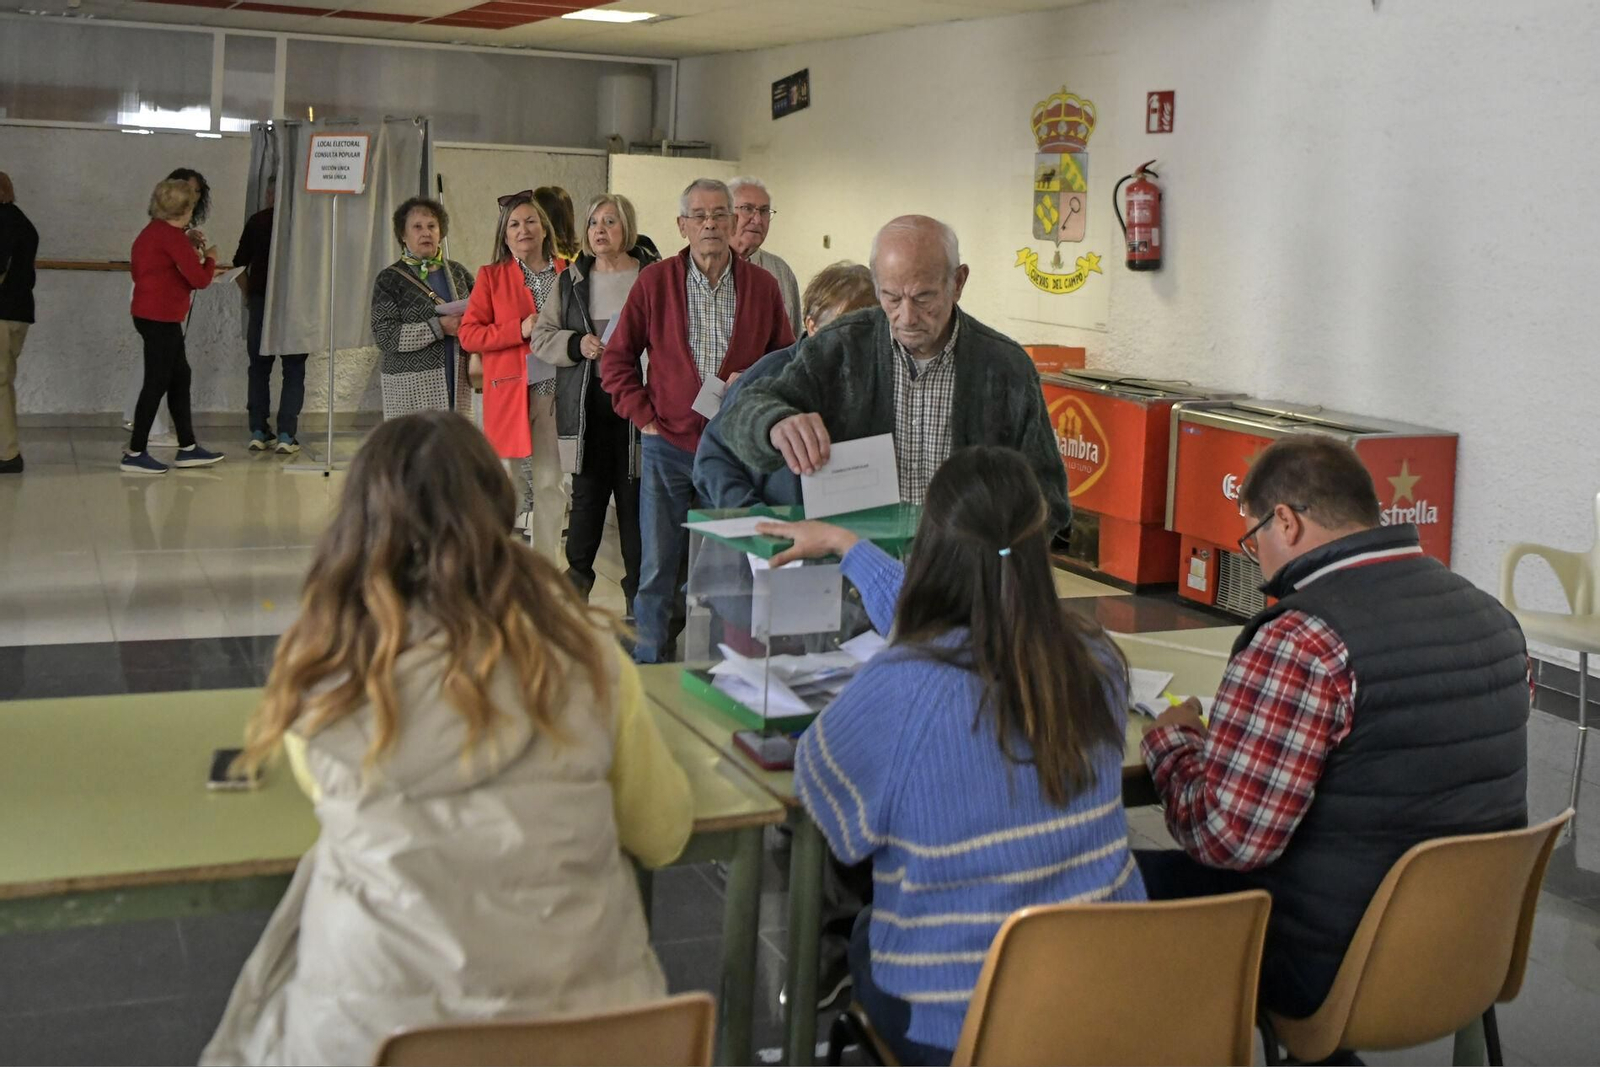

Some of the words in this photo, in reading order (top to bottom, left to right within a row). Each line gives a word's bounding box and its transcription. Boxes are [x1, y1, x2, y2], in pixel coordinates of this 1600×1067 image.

[317, 140, 332, 148] LOCAL
[332, 140, 360, 148] ELECTORAL
[1030, 268, 1049, 289] CUEVAS
[1052, 278, 1063, 290] DEL
[1064, 272, 1083, 289] CAMPO
[1379, 499, 1439, 527] strella
